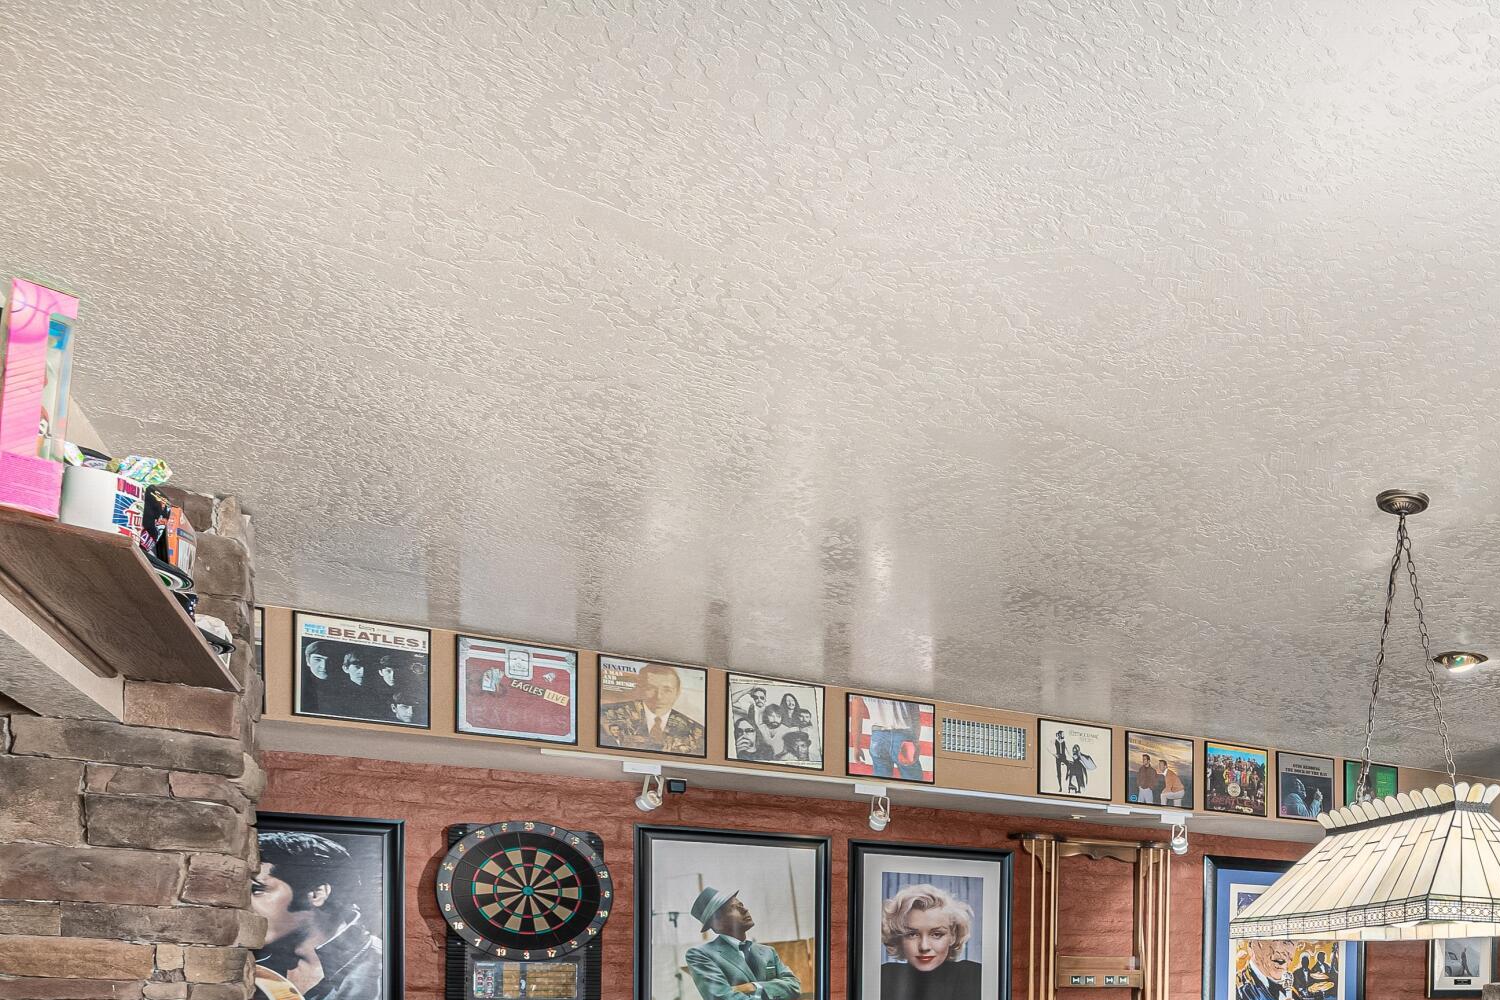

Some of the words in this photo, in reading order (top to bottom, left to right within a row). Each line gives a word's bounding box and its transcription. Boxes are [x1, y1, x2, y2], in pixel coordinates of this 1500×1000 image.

[603, 663, 637, 673] SINATRA
[511, 680, 544, 696] EAGLES
[546, 692, 567, 704] LIVE
